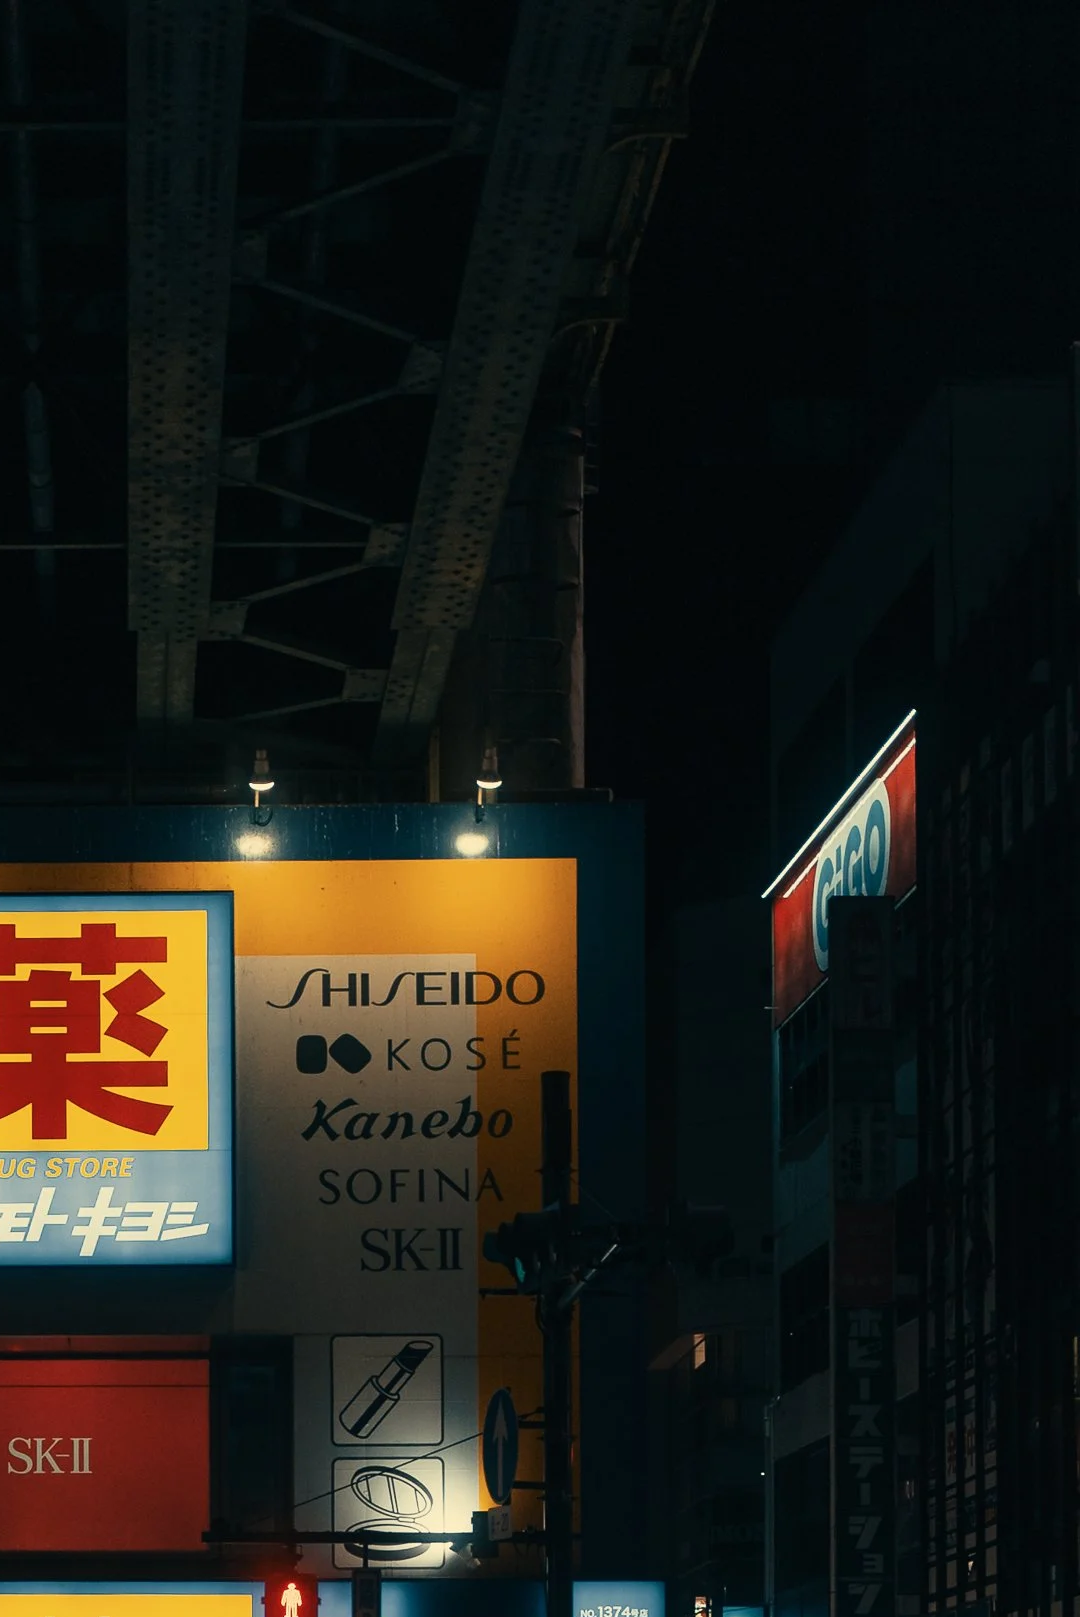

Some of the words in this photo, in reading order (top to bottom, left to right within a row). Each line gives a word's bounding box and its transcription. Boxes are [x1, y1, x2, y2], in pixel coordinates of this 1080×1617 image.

[266, 968, 546, 1010] SHISEIDO
[387, 1029, 522, 1072] KOSÉ
[301, 1095, 513, 1142] Kanebo
[44, 1157, 135, 1179] STORE
[318, 1168, 504, 1205] SOFINA
[359, 1227, 464, 1273] SK-II
[7, 1436, 93, 1475] SK-II
